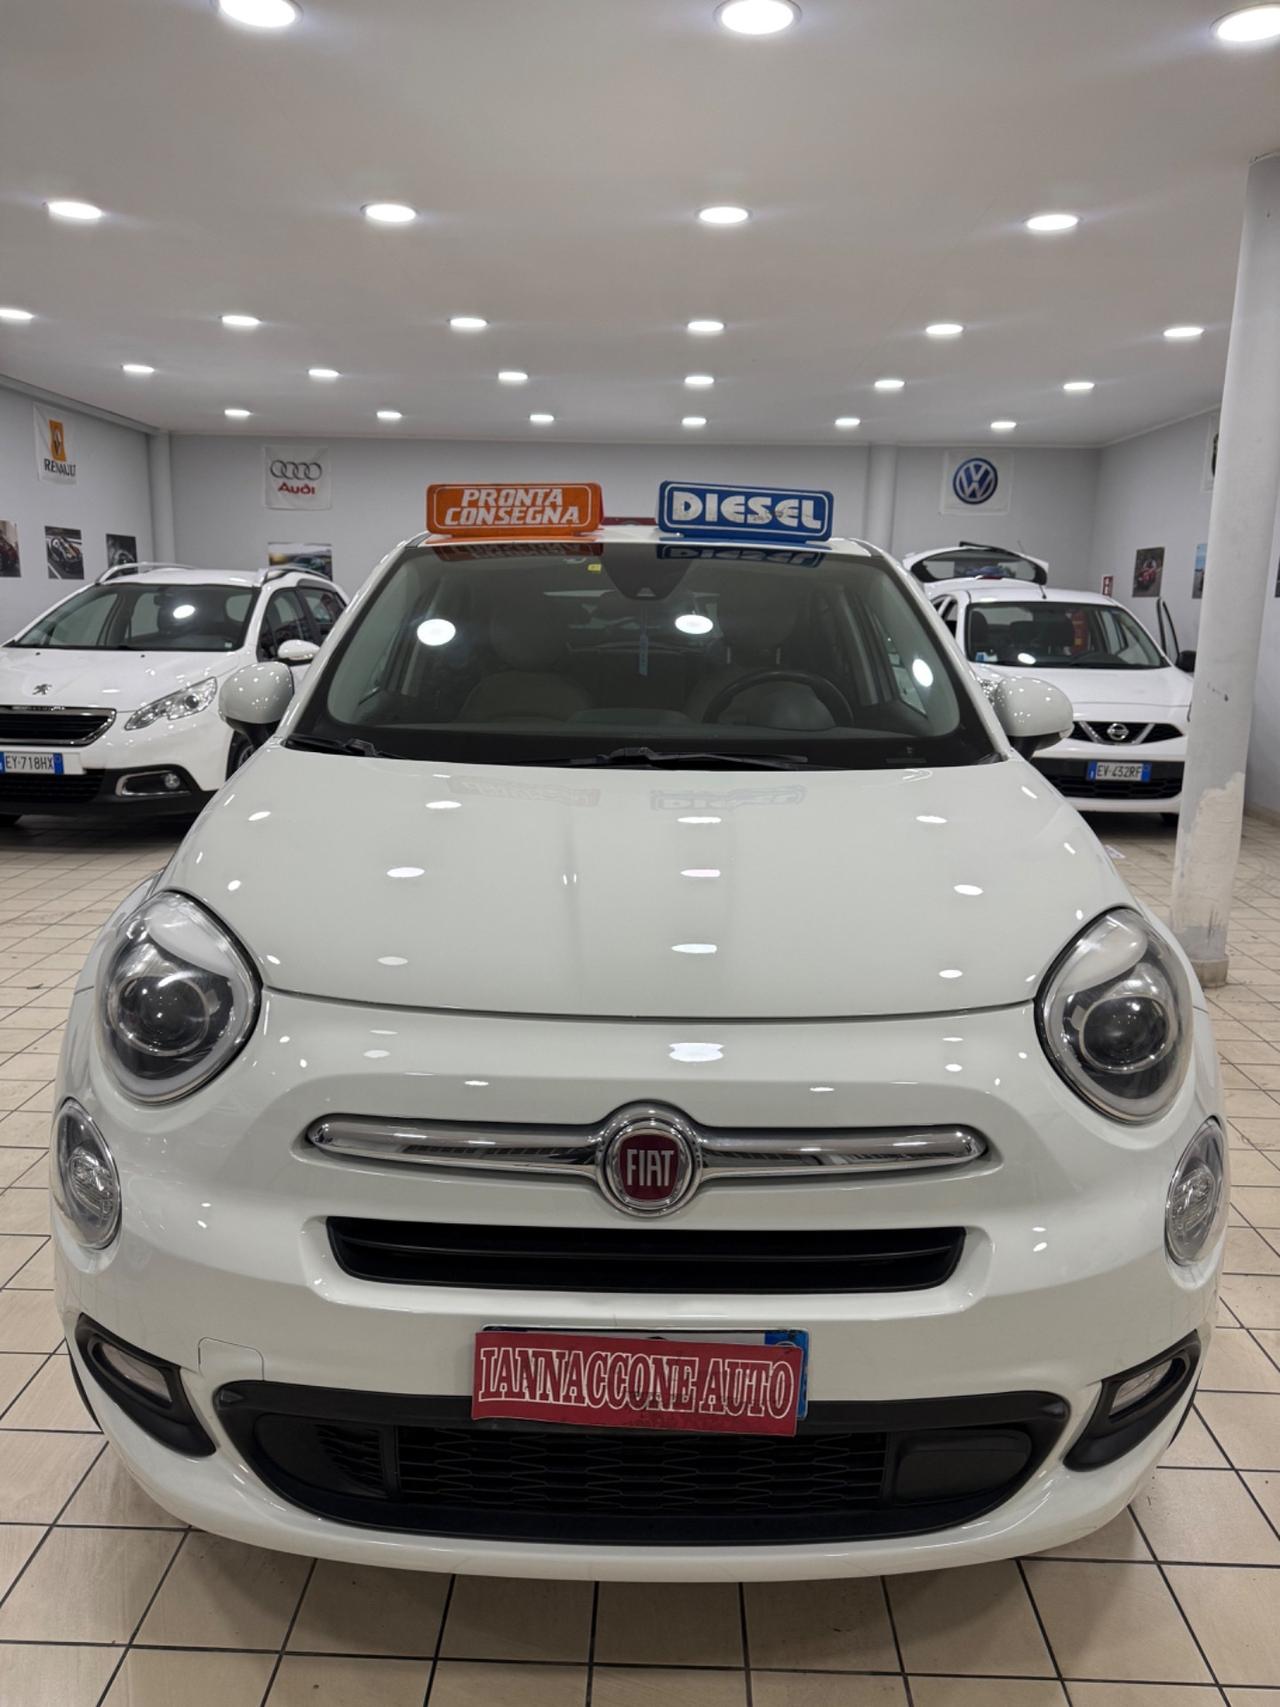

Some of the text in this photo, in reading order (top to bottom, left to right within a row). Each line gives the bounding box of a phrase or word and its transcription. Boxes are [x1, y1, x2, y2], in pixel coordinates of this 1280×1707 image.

[44, 458, 76, 477] RENAULT
[277, 482, 315, 495] Audi
[461, 488, 563, 507] PRONTA
[445, 506, 580, 526] CONSEGNA
[672, 491, 822, 529] DIESEL
[626, 1149, 675, 1187] FIAT
[479, 1347, 794, 1419] IANNACCONE AUTO
